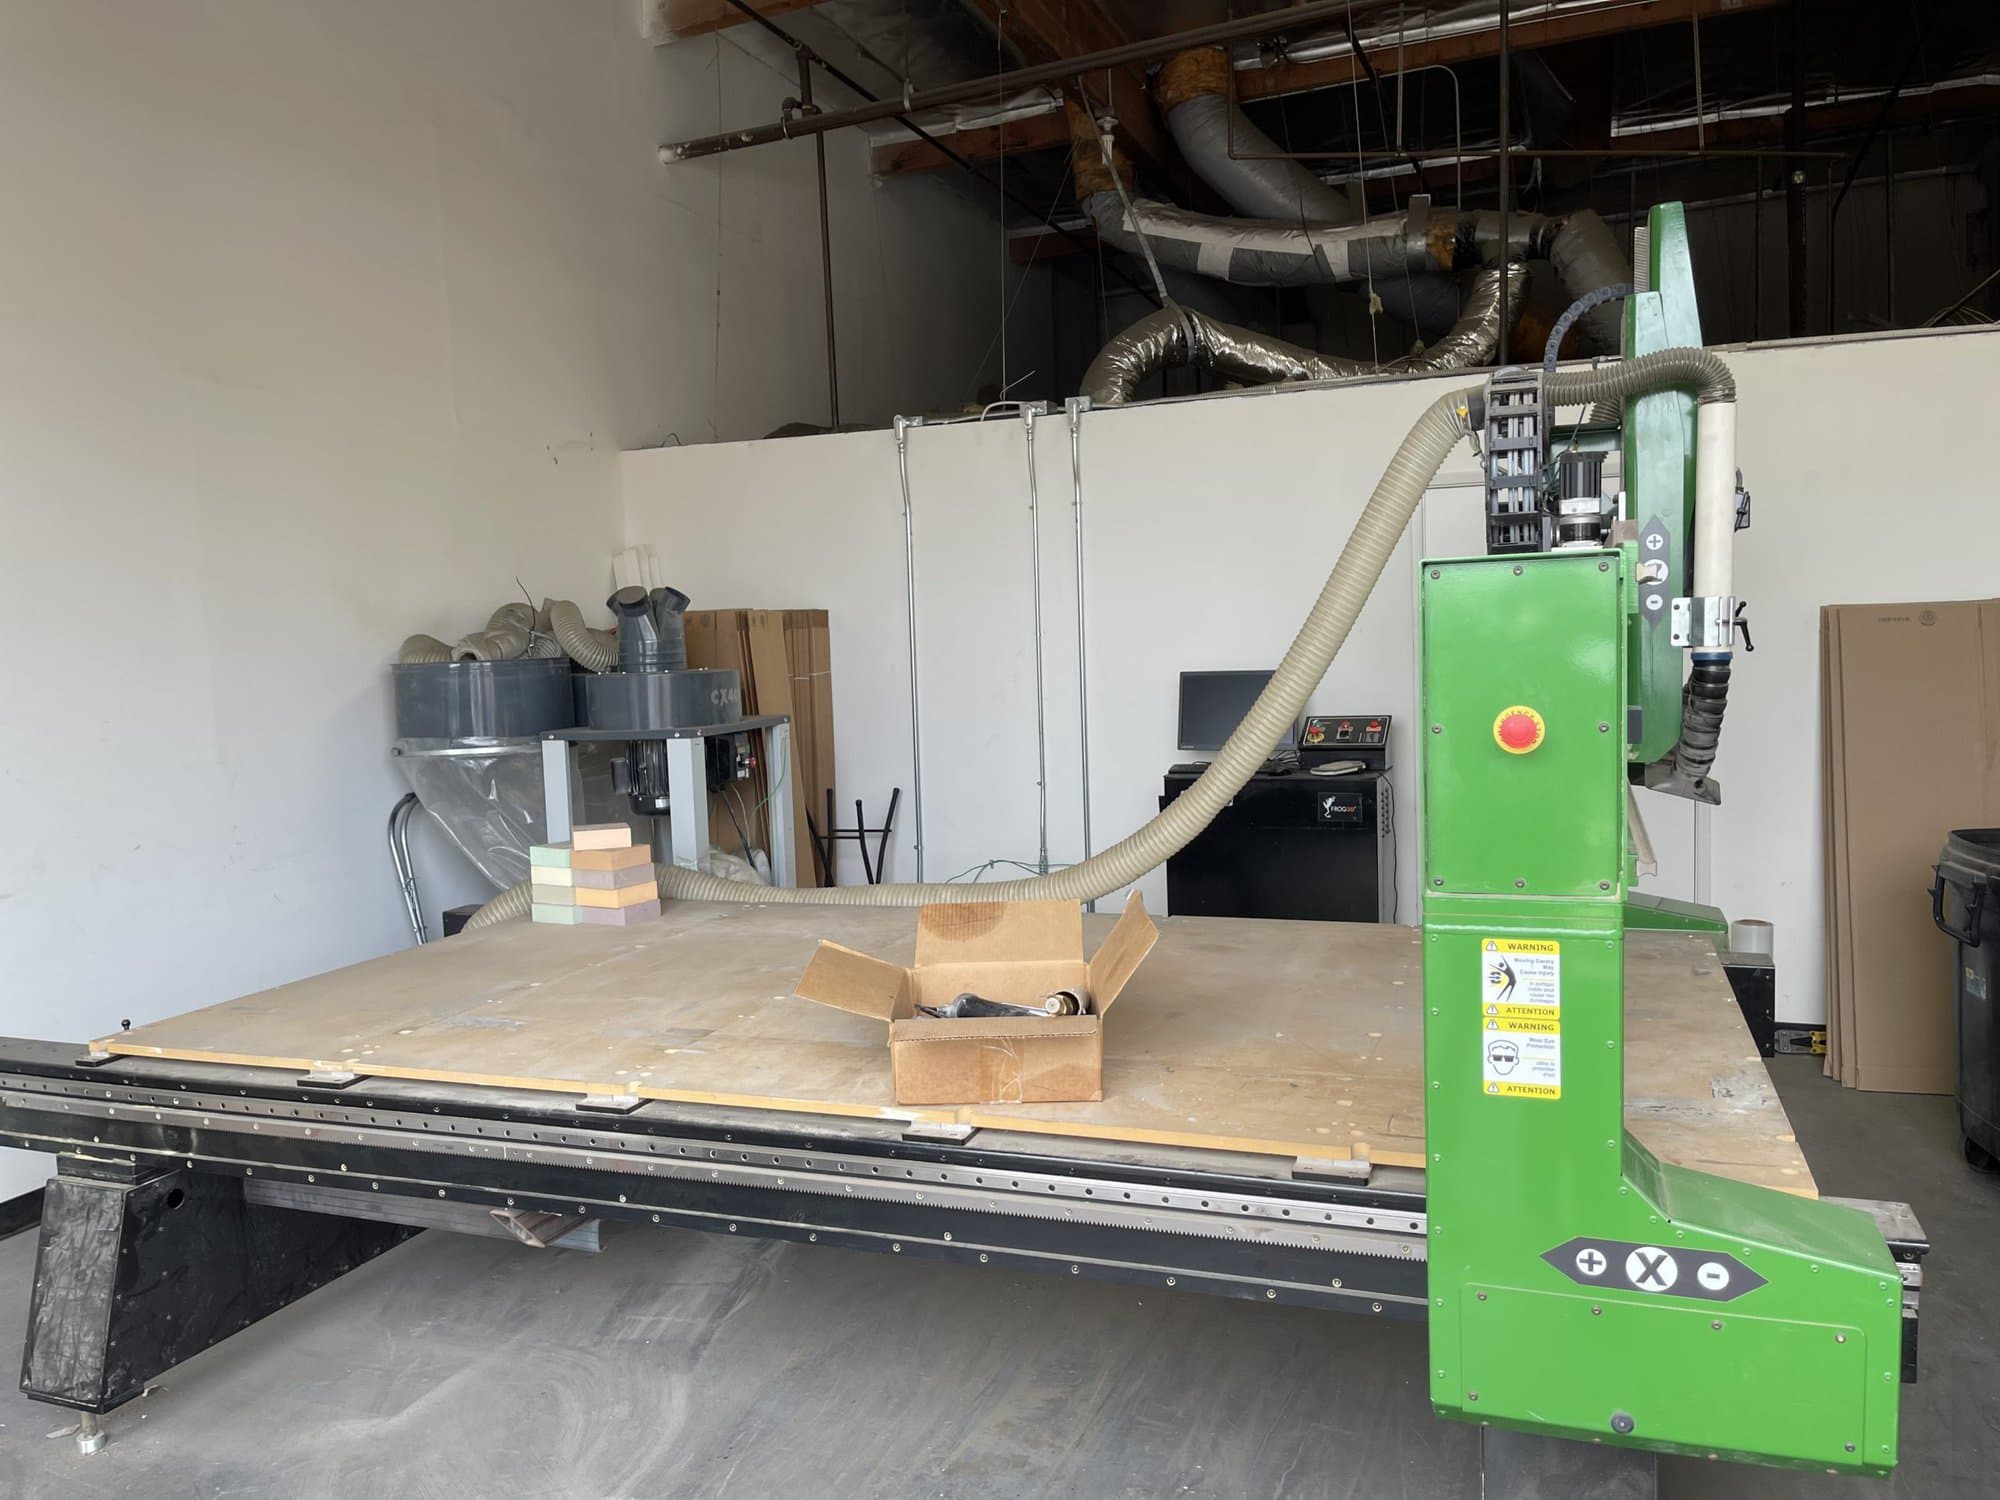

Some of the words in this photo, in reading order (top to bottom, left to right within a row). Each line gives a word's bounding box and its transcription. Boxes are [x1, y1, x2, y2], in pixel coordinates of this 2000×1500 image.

[1507, 943, 1554, 952] WARNING
[1506, 1007, 1555, 1016] ATTENTION
[1508, 1022, 1554, 1031] WARNING
[1506, 1085, 1556, 1095] ATTENTION
[1635, 1252, 1669, 1286] X
